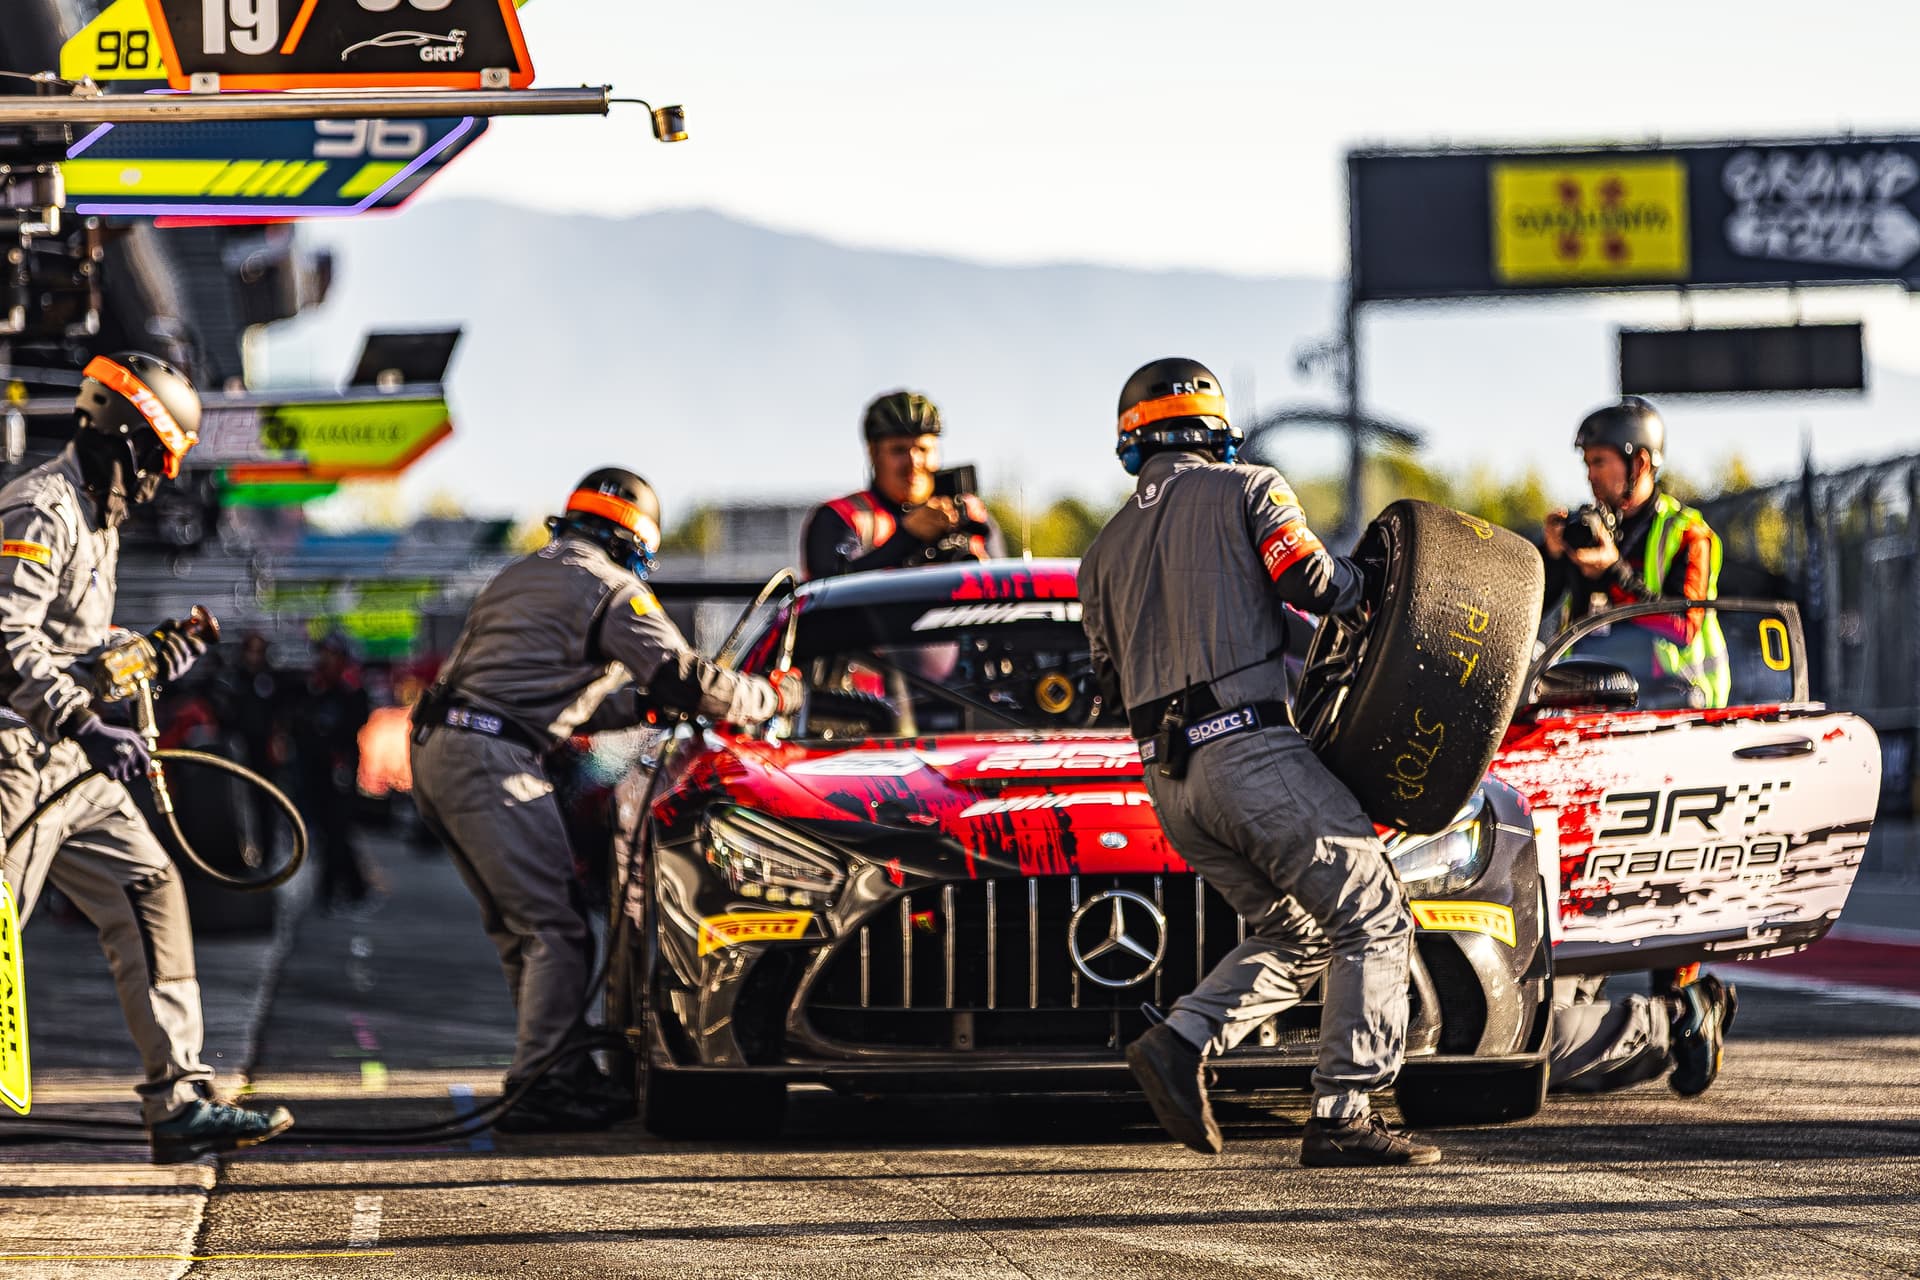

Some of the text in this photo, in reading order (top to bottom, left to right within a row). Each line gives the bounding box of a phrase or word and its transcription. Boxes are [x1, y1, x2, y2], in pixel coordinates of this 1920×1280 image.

[97, 30, 149, 70] 98
[202, 0, 279, 55] 19
[420, 46, 458, 62] GRT
[1385, 601, 1489, 801] PIT STOP
[1188, 709, 1252, 744] sparco
[1599, 785, 1727, 840] 3R
